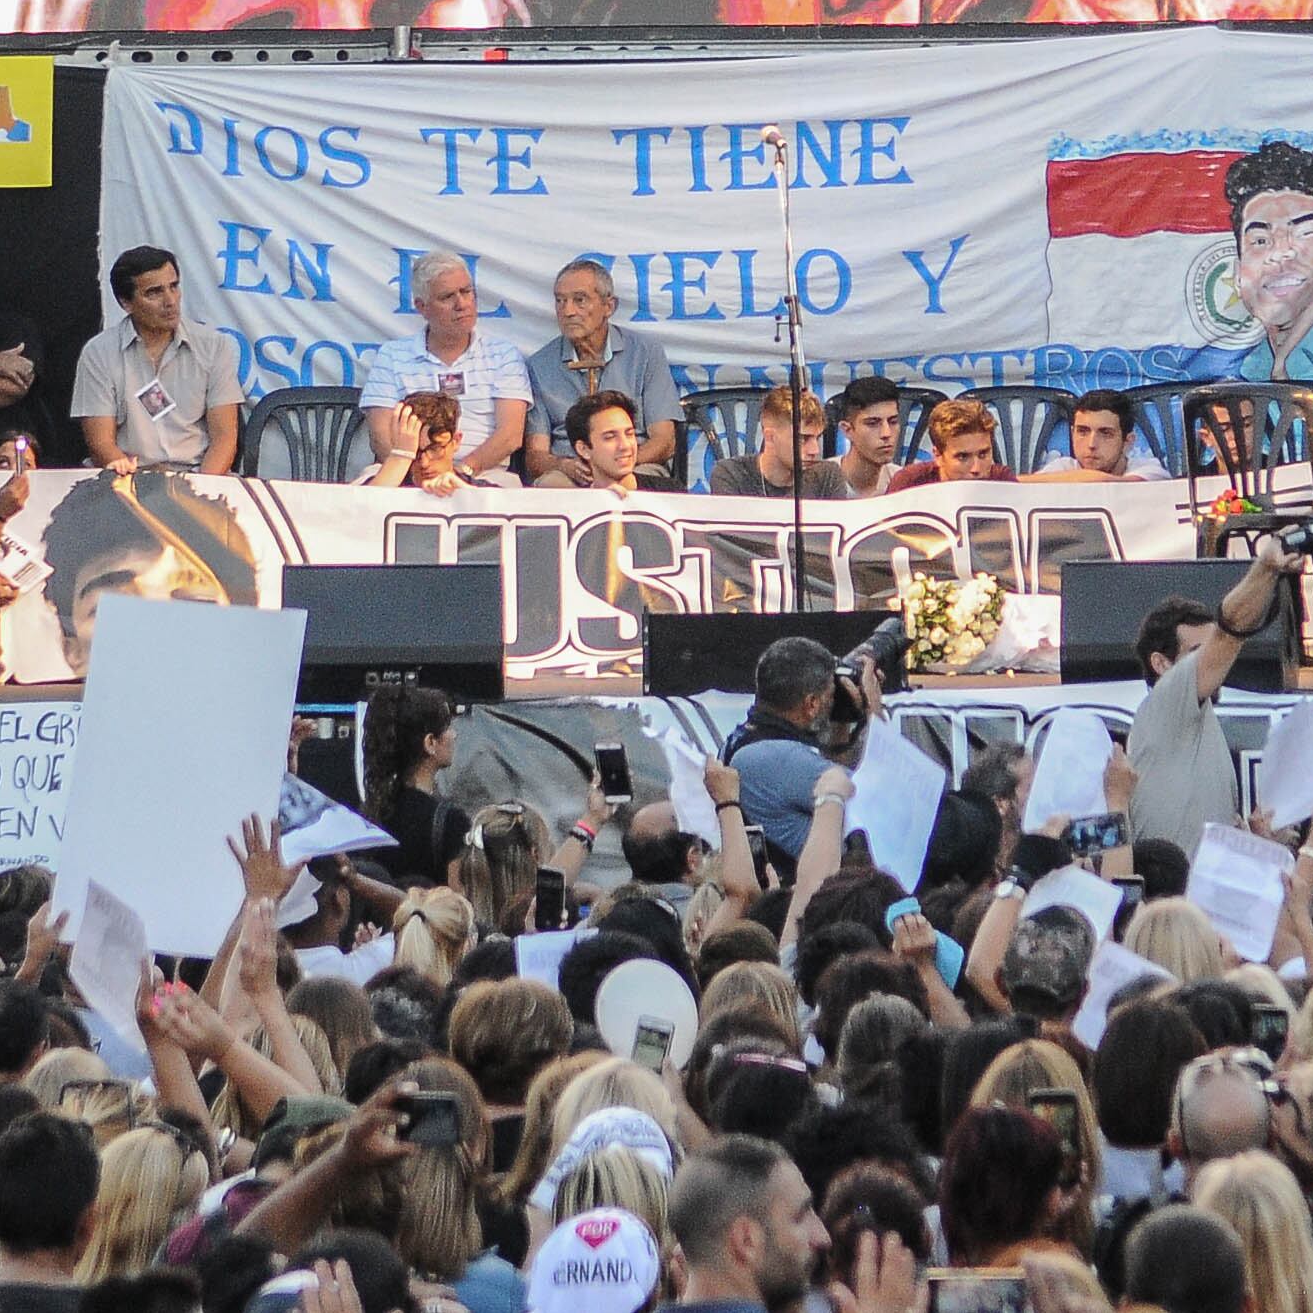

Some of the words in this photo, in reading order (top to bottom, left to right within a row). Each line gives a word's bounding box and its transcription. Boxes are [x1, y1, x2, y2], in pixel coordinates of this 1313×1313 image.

[154, 100, 373, 188] DIOS
[421, 126, 550, 197] TE
[612, 115, 914, 197] TIENE
[218, 219, 336, 304] EN
[570, 248, 852, 323] IELO
[902, 233, 970, 315] Y
[13, 753, 65, 803] QUE
